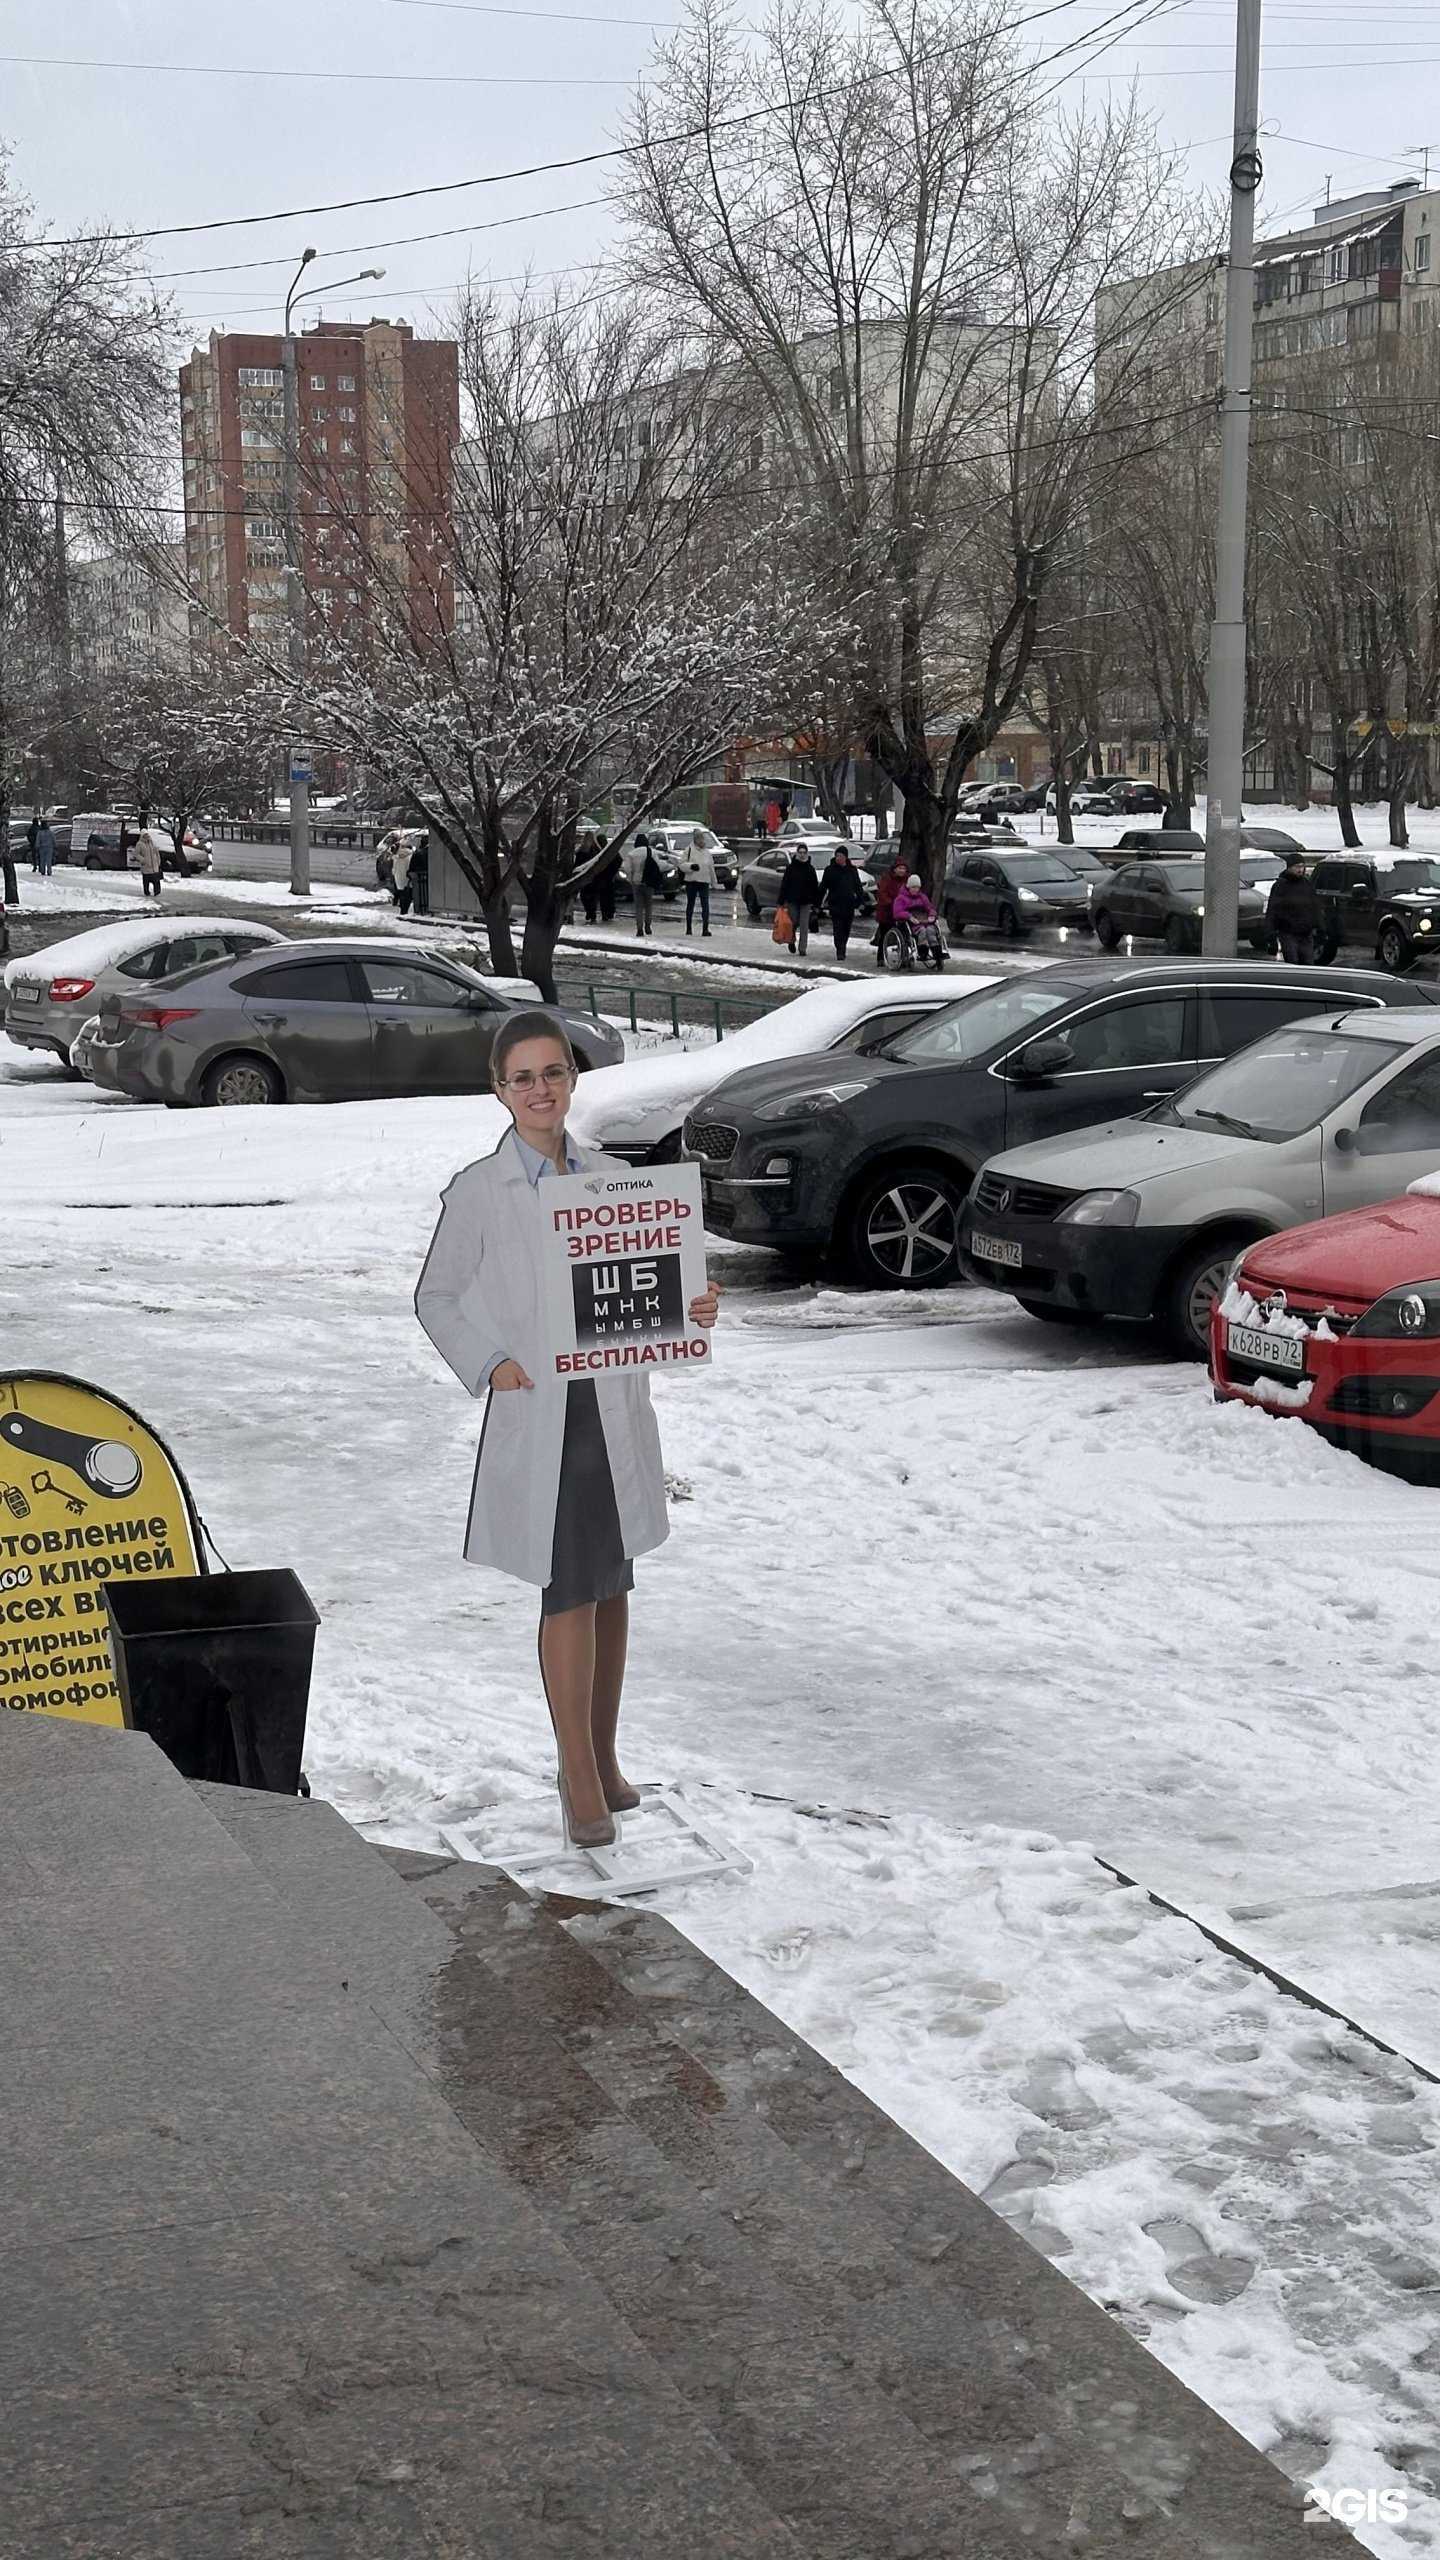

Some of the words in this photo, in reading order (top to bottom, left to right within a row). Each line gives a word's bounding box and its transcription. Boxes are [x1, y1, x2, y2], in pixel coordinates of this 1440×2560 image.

[606, 1179, 654, 1192] ОПТИКА
[553, 1198, 691, 1231] ПРОВЕРЬ
[567, 1226, 682, 1258] ЗРЕНИЕ
[555, 1339, 708, 1373] БЕСПЛАТНО
[0, 1517, 167, 1557] товление
[0, 1565, 32, 1592] ое
[39, 1541, 174, 1586] ключей
[0, 1595, 65, 1625] сех
[0, 1681, 121, 1711] омофон
